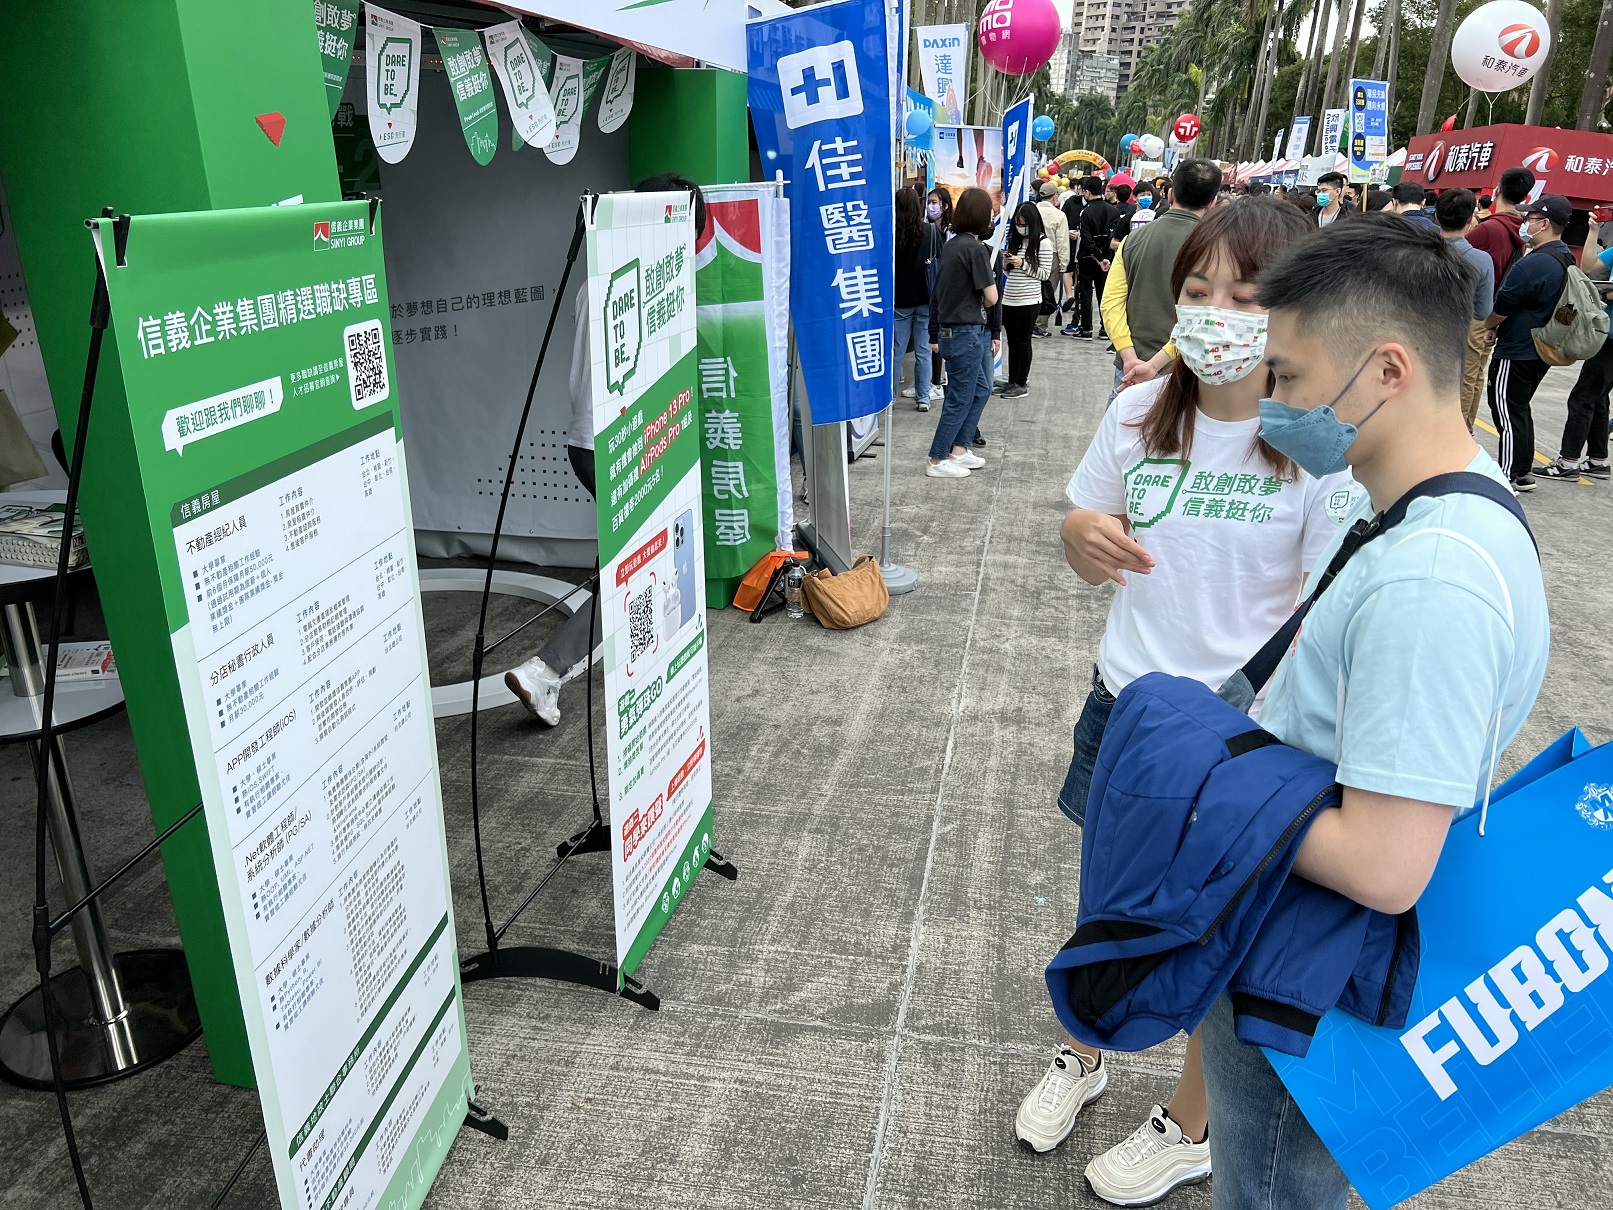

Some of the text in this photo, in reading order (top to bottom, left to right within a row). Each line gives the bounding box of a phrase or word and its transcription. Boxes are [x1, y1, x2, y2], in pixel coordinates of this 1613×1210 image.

[385, 54, 406, 67] DARE
[446, 44, 482, 77] 敢創敢夢
[510, 52, 526, 72] DARE
[1481, 54, 1530, 78] 和泰汽車
[386, 69, 396, 82] TO
[456, 72, 488, 102] 信義挺你
[514, 70, 523, 83] TO
[561, 98, 568, 107] TO
[562, 86, 577, 98] DARE
[1444, 140, 1494, 172] 和泰汽車
[330, 235, 366, 249] SINYI GROUP
[644, 246, 686, 299] 敢創敢夢
[804, 136, 885, 382] 佳醫集團
[137, 274, 380, 359] 信義企業集團精選職缺專區
[390, 285, 558, 320] 於夢想自己的理想藍圖，
[612, 288, 636, 320] DARE
[646, 285, 686, 338] 信義挺你
[613, 320, 626, 342] TO
[176, 388, 274, 438] 歡迎跟我們聊聊！
[608, 410, 644, 454] 玩30秒小遊戲
[609, 434, 644, 482] 就有機會抽到
[644, 412, 668, 446] iPhone
[668, 400, 678, 418] 13
[360, 449, 380, 466] 工作地點
[640, 436, 668, 475] AirPods
[668, 423, 680, 444] Pro
[1130, 488, 1146, 500] TO
[1134, 474, 1172, 488] DARE
[1190, 471, 1283, 496] 敢創敢夢
[181, 490, 220, 518] 信義房屋
[278, 486, 304, 507] 工作內容
[1182, 497, 1274, 524] 信義挺你
[186, 514, 248, 556] 不動產經紀人員
[210, 632, 274, 686] 分店秘書行政人員
